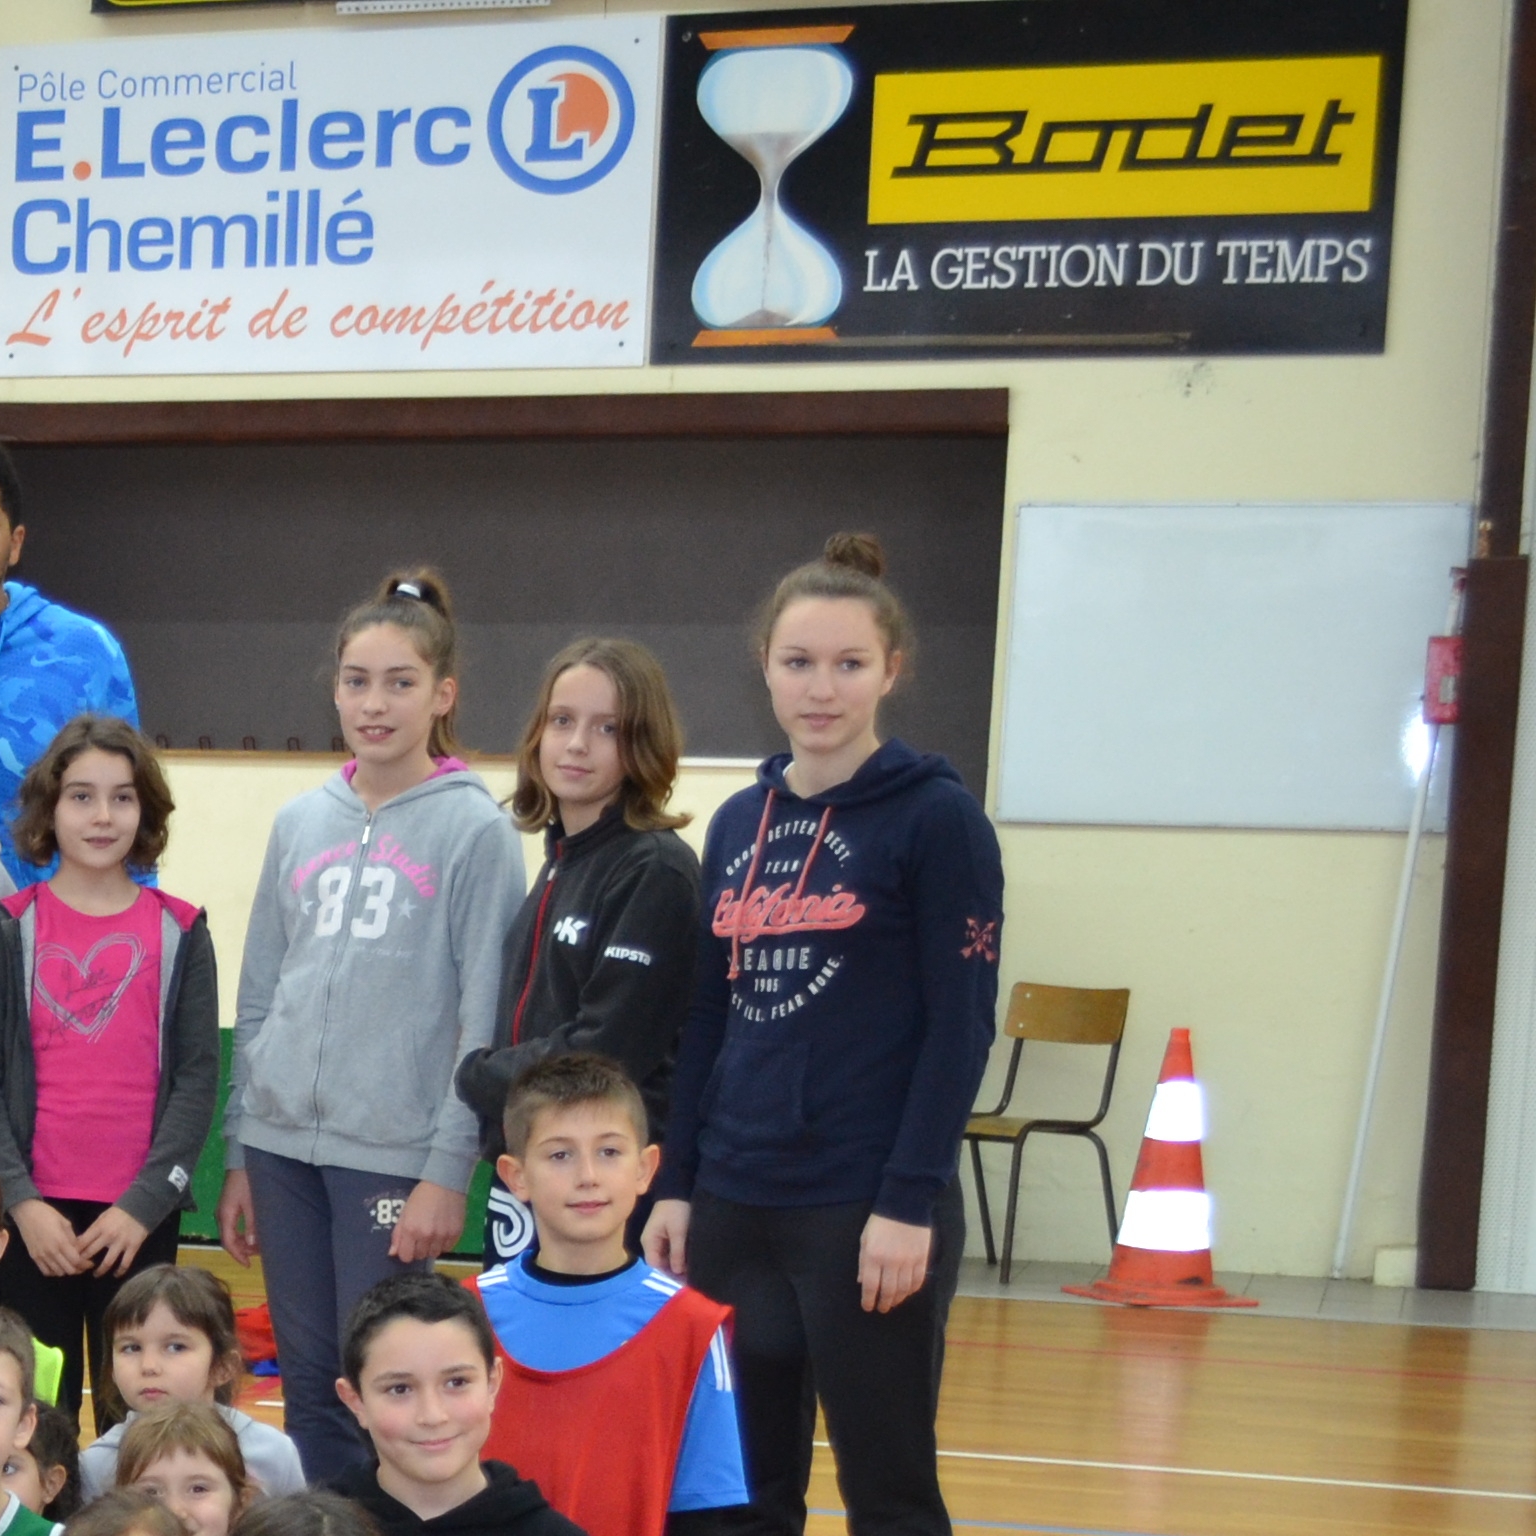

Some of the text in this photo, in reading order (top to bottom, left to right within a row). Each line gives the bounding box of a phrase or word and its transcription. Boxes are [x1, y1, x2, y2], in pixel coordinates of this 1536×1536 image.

[17, 61, 298, 103] Pôle Commercial
[14, 98, 472, 184] E.Leclerc
[889, 98, 1356, 180] Bodet
[10, 187, 375, 277] Chemillé
[862, 236, 1372, 292] LA GESTION DU TEMPS
[4, 279, 632, 356] L'esprit de compétition
[368, 832, 437, 898] Studio
[314, 866, 397, 940] 83
